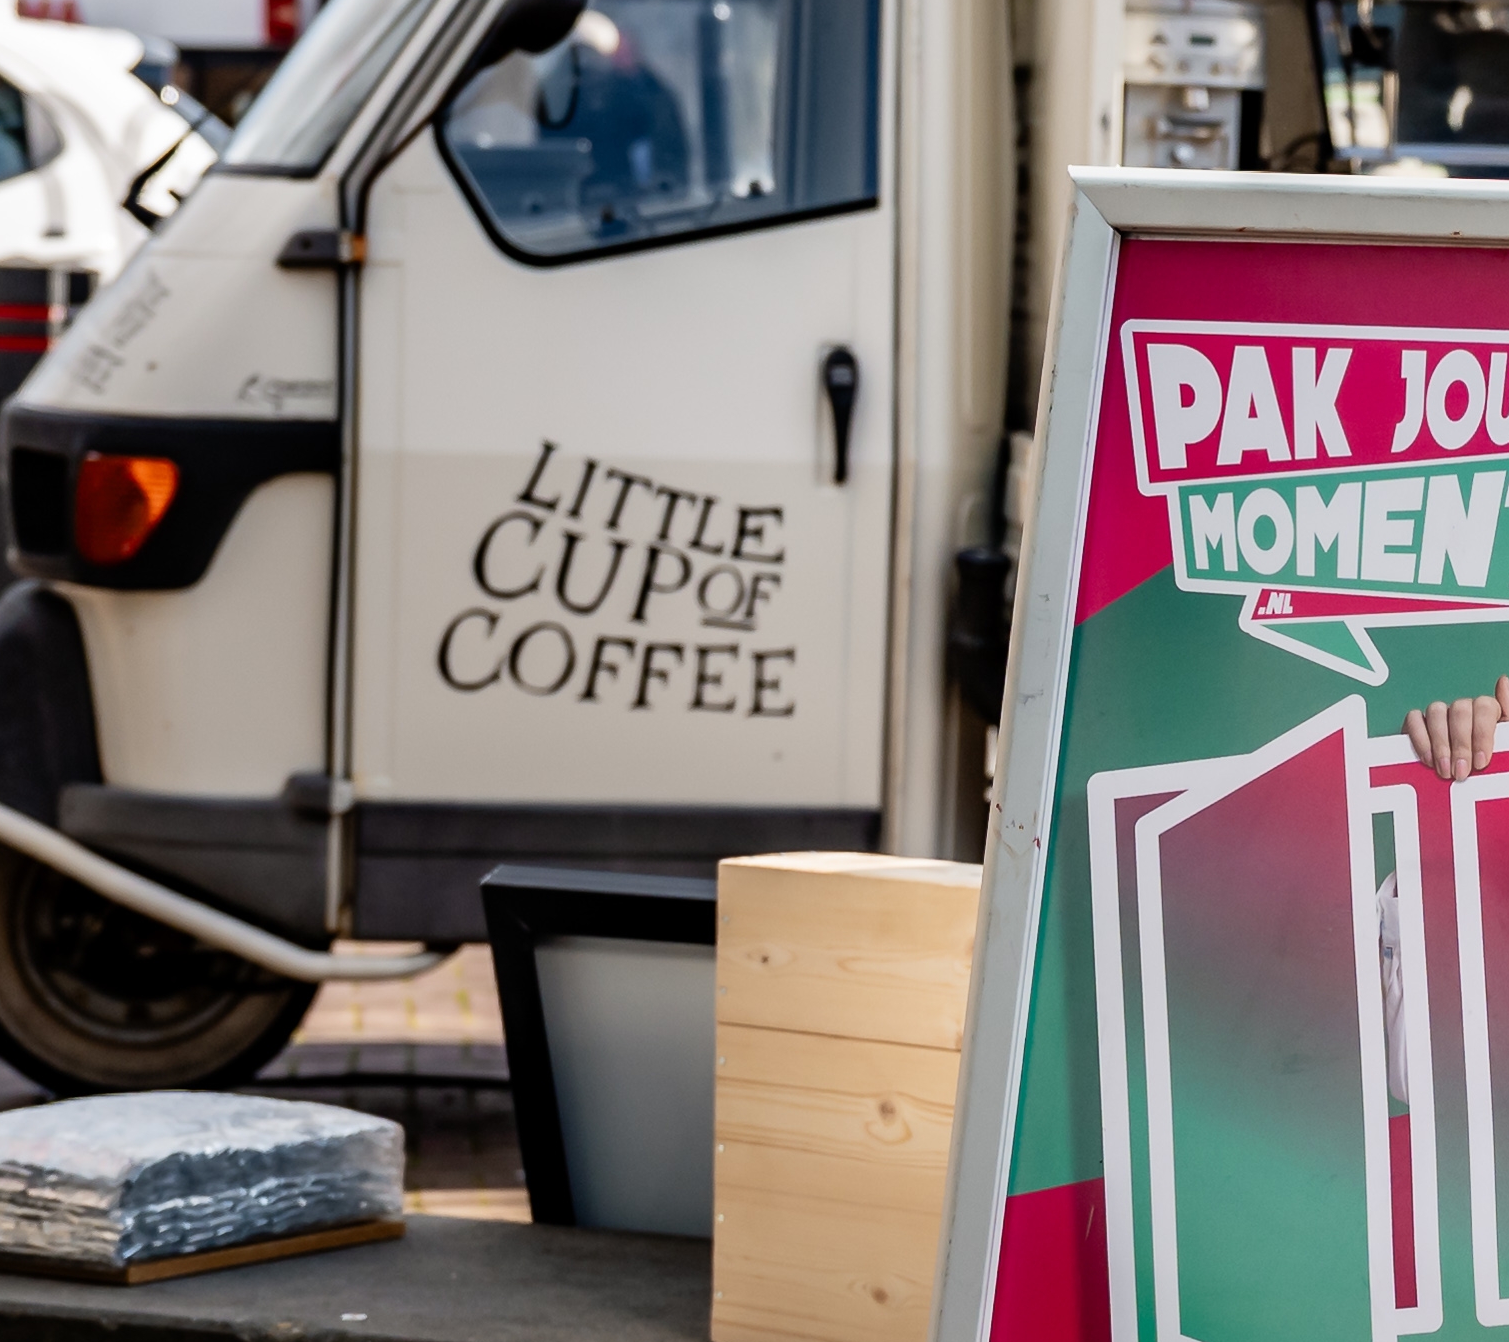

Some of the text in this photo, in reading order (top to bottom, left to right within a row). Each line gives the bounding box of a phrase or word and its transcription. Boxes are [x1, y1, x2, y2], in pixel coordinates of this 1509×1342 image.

[1146, 342, 1354, 470] PAK
[516, 439, 786, 564] LITTLE
[472, 510, 781, 630] CUP OF
[1257, 591, 1293, 616] .NL
[437, 607, 797, 718] COFFEE
